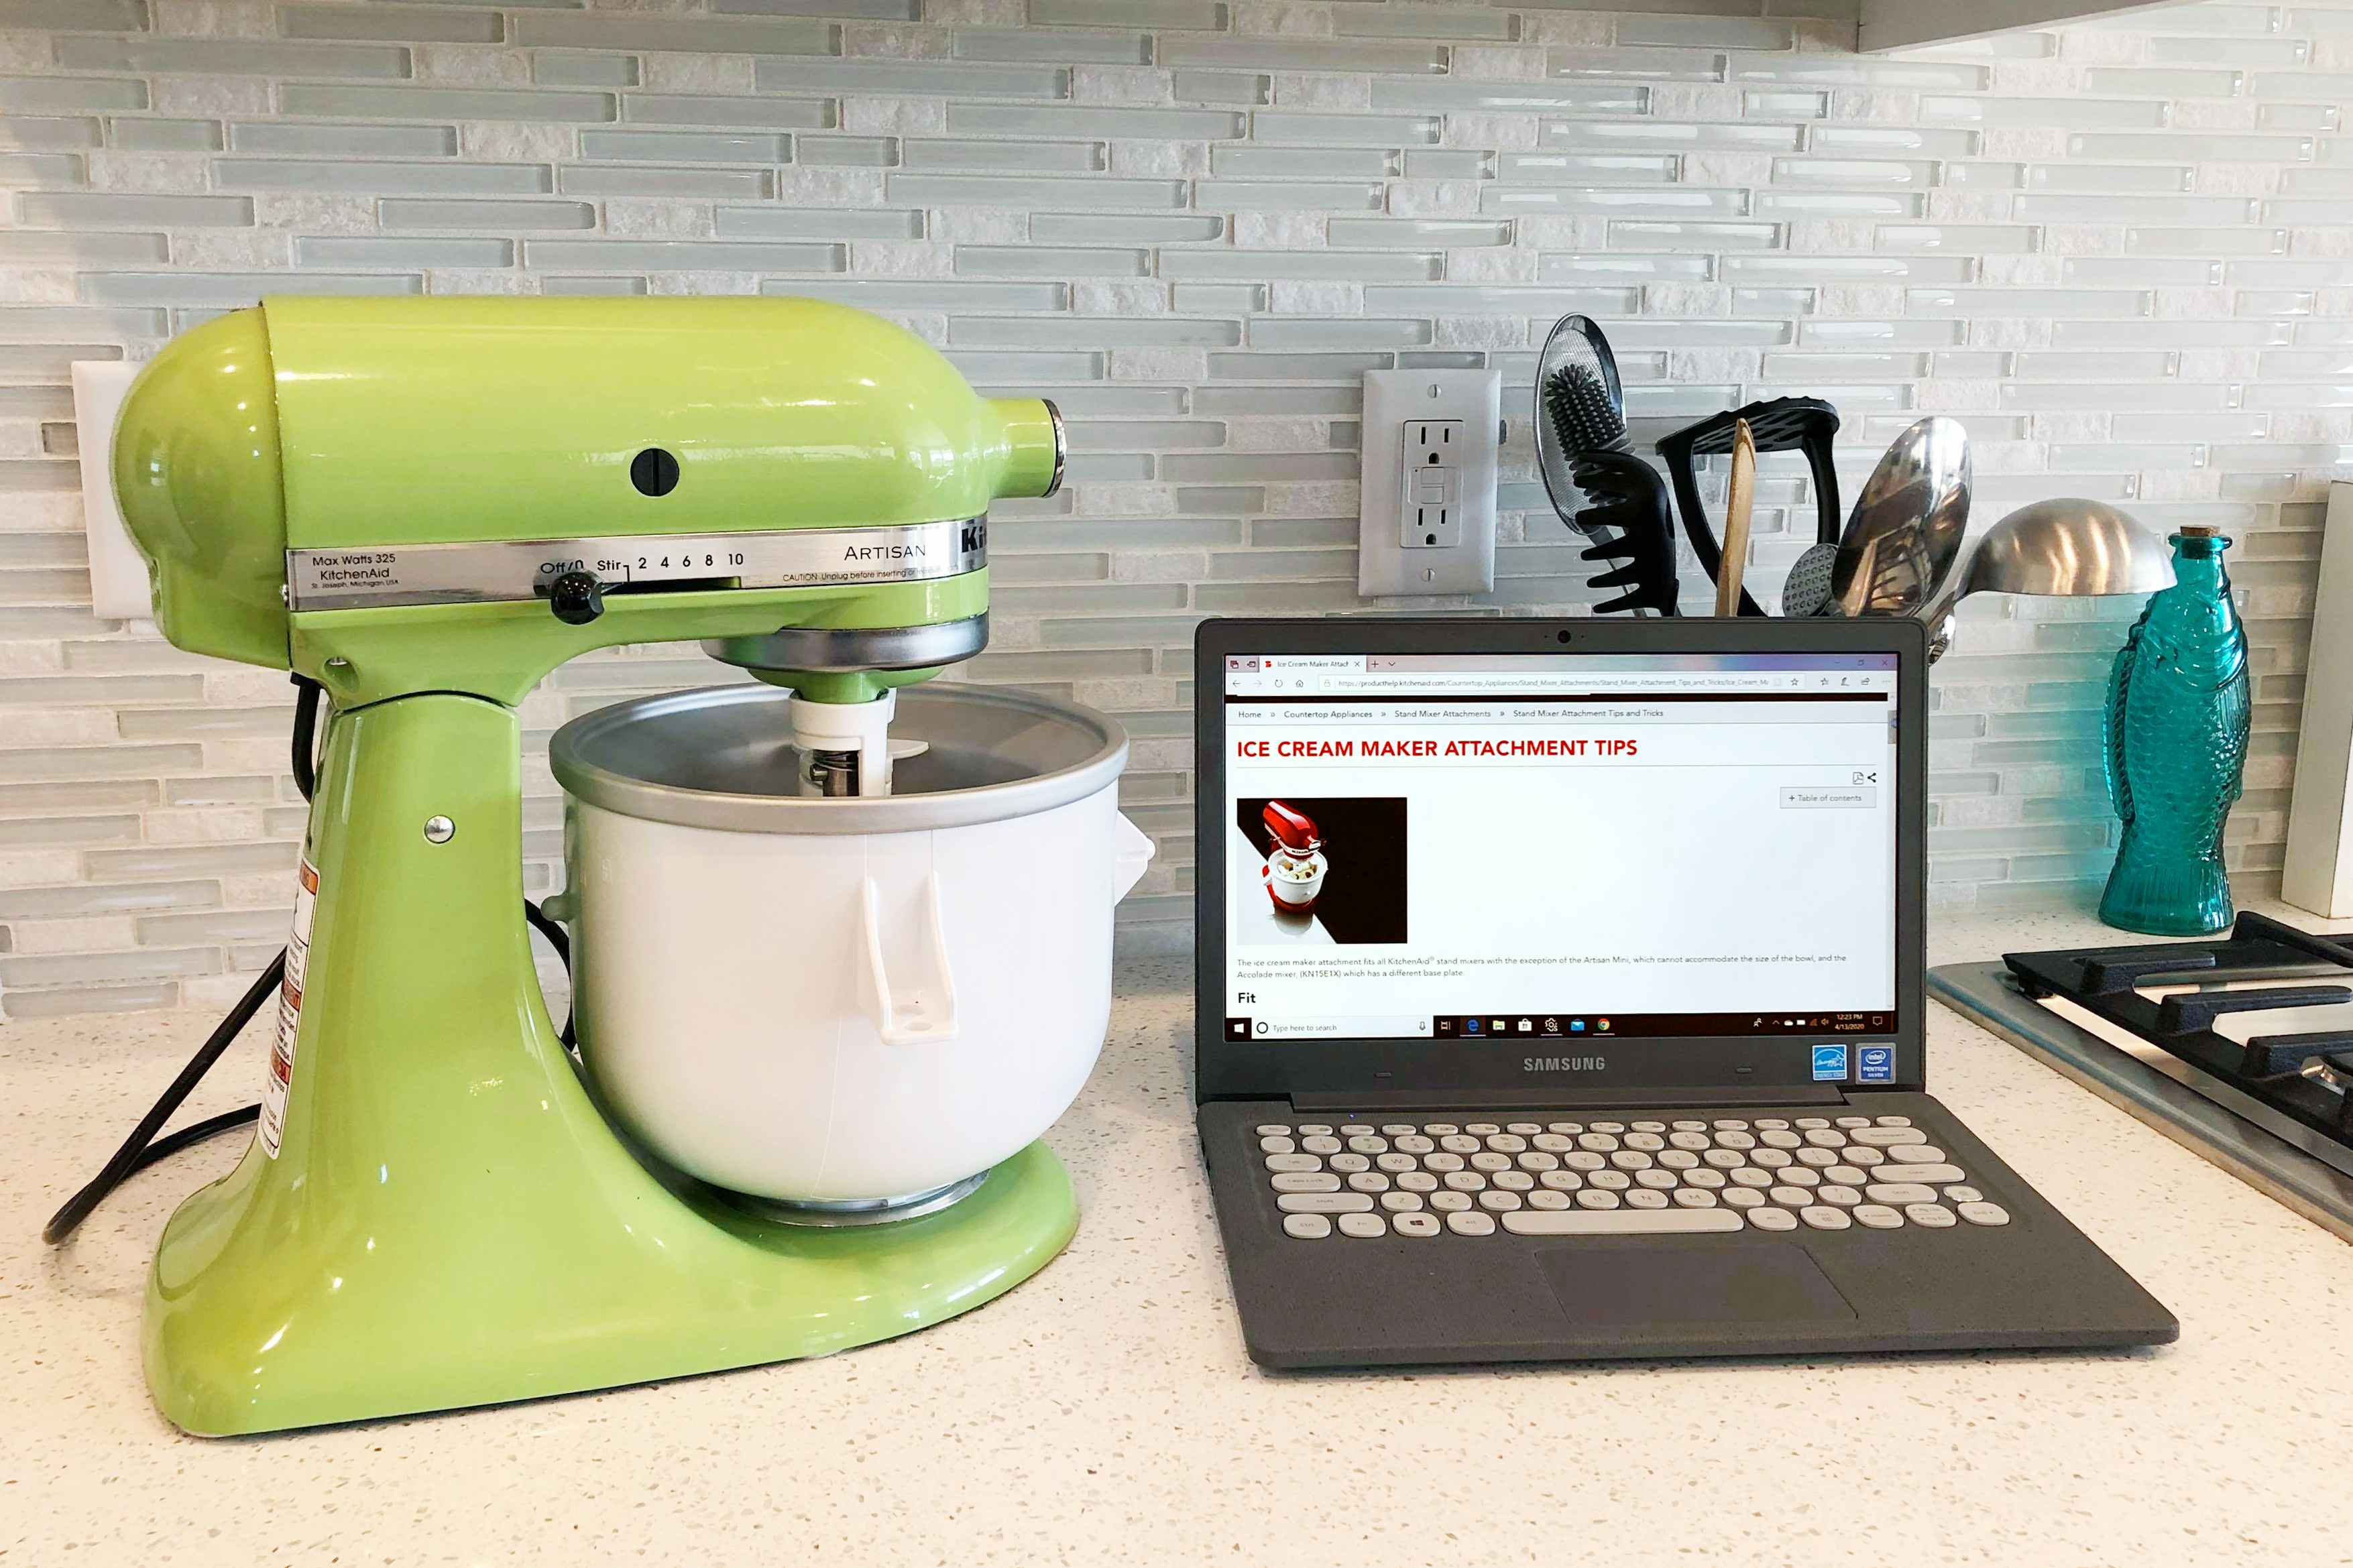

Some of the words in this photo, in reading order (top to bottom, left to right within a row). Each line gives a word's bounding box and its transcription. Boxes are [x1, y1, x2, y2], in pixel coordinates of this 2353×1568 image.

[312, 556, 339, 566] Max
[341, 555, 373, 564] Watts
[376, 554, 396, 563] 325
[844, 546, 925, 561] ARTISAN
[597, 559, 622, 571] Stir
[638, 557, 647, 570] 2
[661, 556, 669, 568] 4
[682, 555, 691, 567] 6
[705, 554, 713, 566] 8
[728, 553, 744, 565] 10
[320, 567, 390, 581] KitchenAid
[821, 571, 848, 581] Unplug
[850, 570, 874, 579] before
[877, 569, 906, 579] inserting
[1284, 711, 1328, 719] Countertop
[1330, 711, 1372, 719] Appliances
[1608, 710, 1623, 718] Tips
[1237, 741, 1269, 757] ICE
[1277, 741, 1353, 757] CREAM
[1361, 740, 1437, 756] MAKER
[1444, 739, 1588, 756] ATTACHMENT
[1595, 739, 1638, 756] TIPS
[1519, 957, 1556, 965] exception
[1613, 957, 1631, 965] Mini,
[1238, 992, 1256, 1004] Fit
[1524, 1057, 1605, 1071] SAMSUNG
